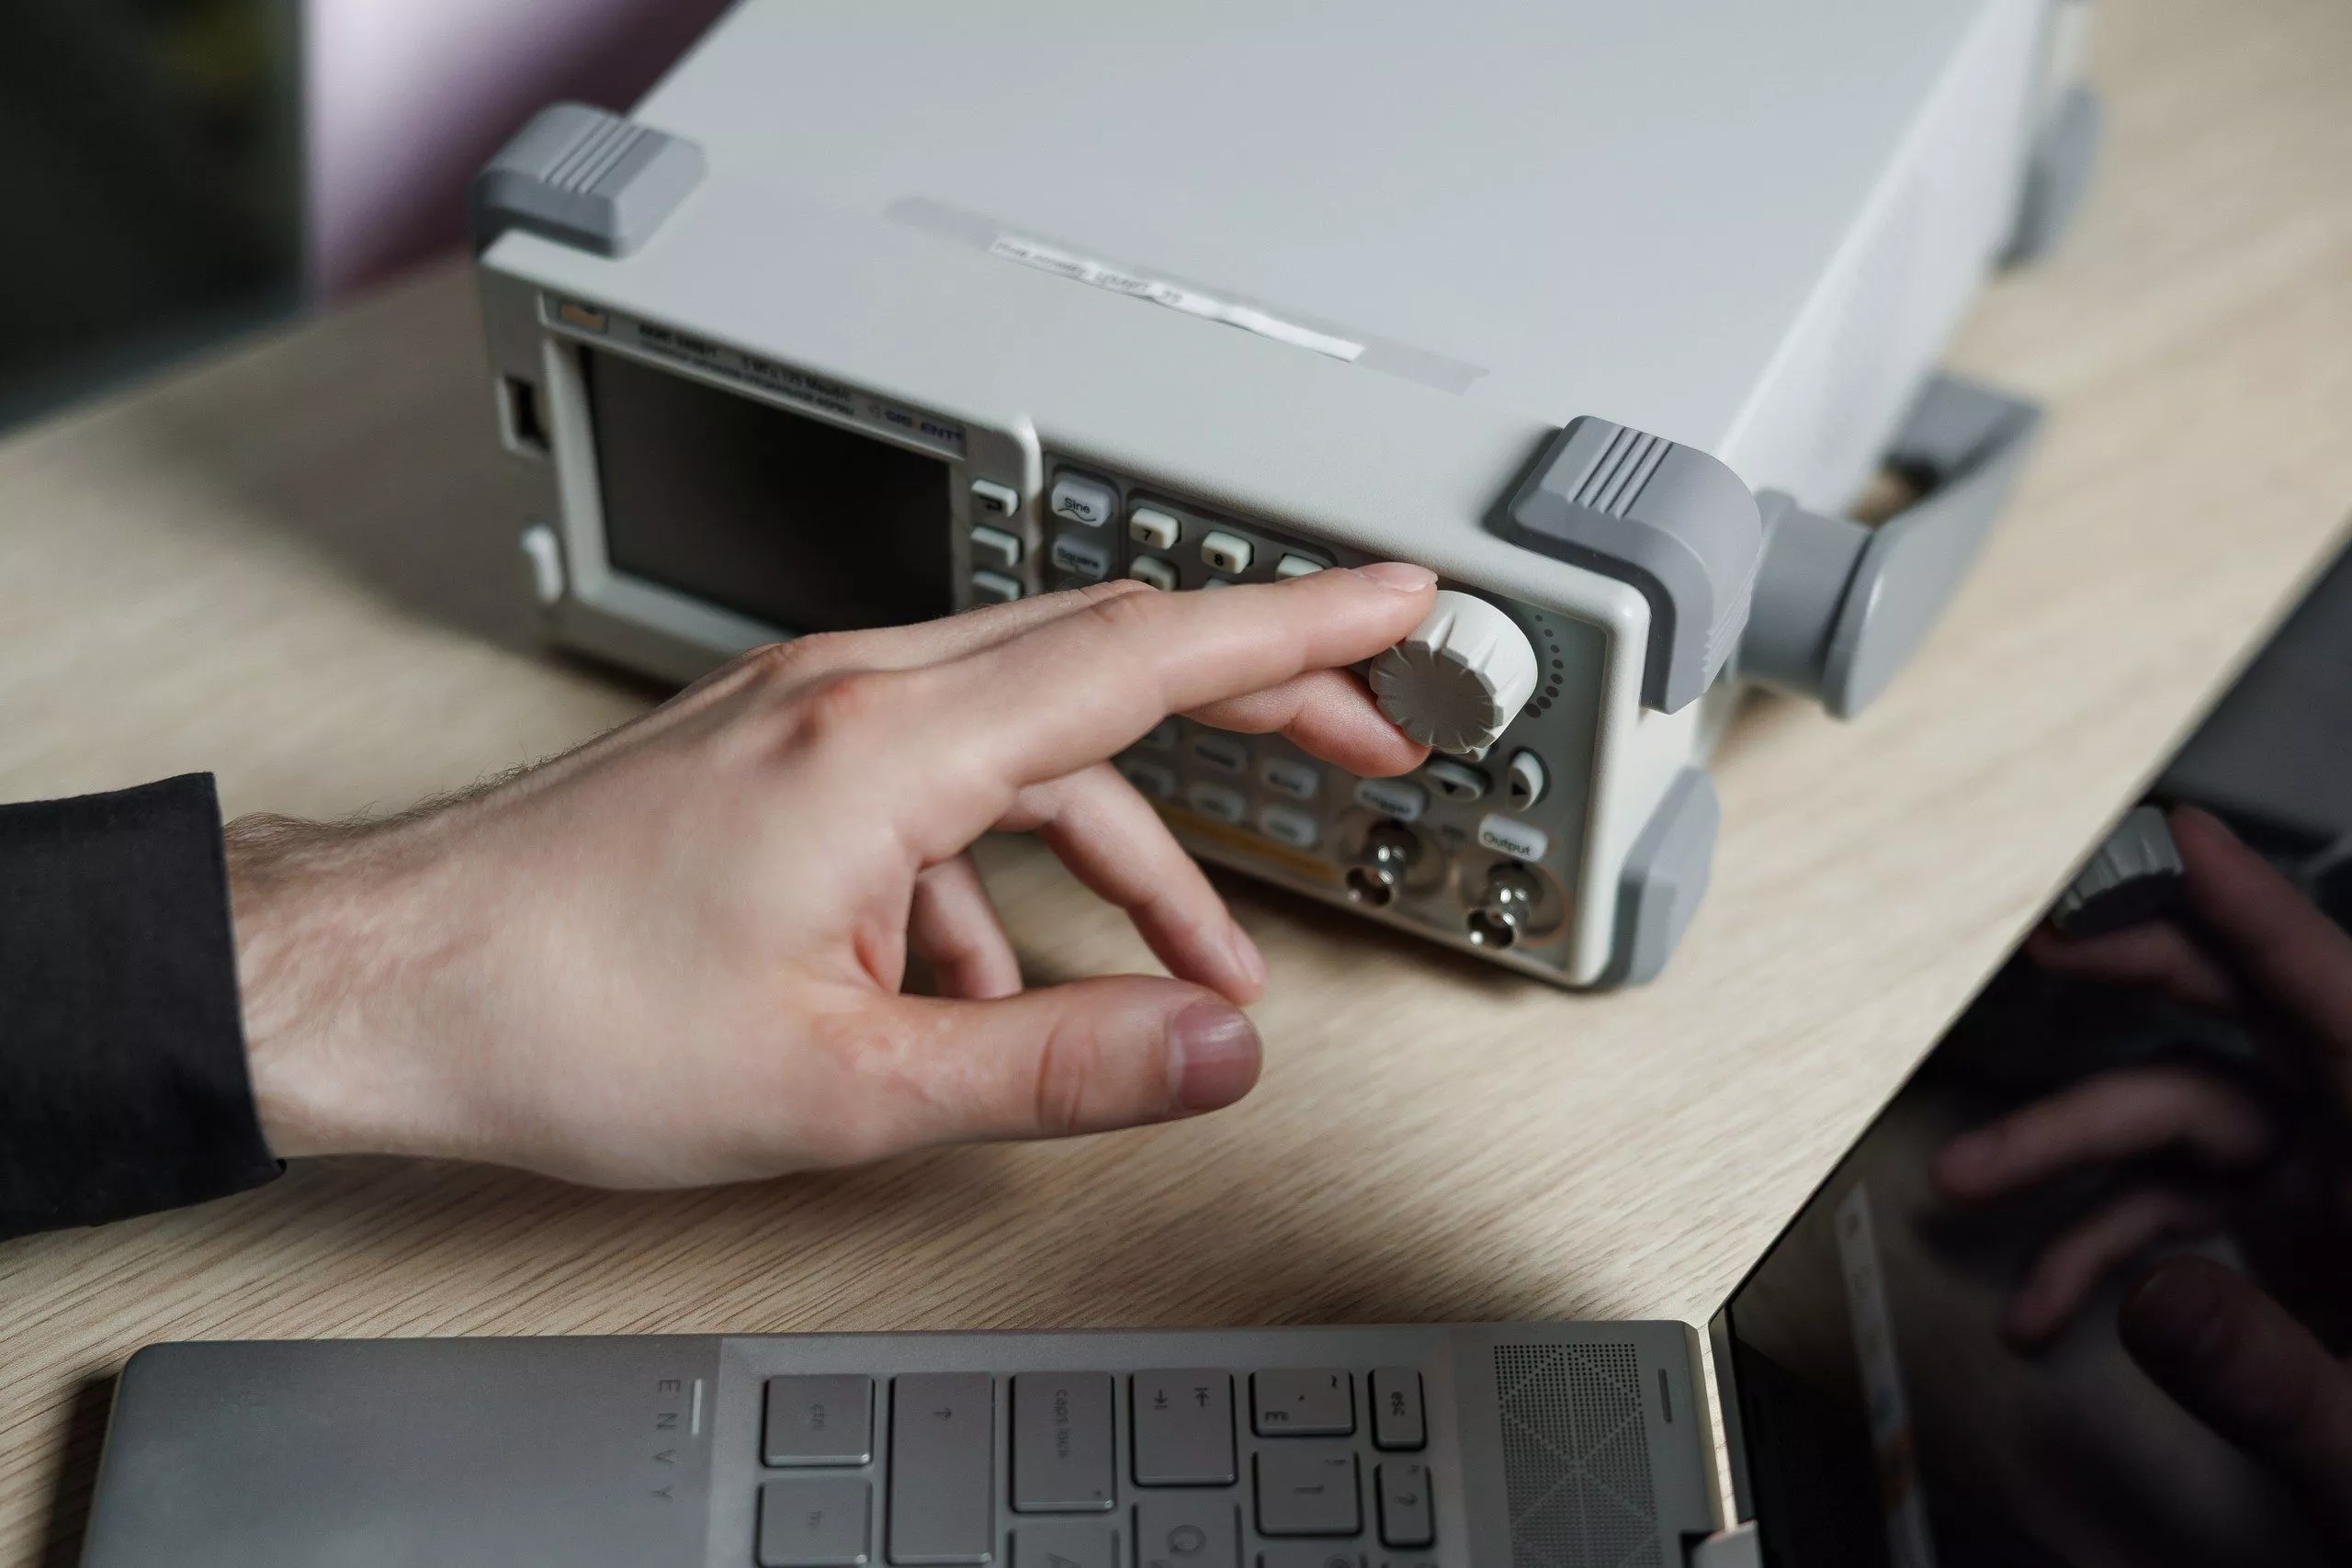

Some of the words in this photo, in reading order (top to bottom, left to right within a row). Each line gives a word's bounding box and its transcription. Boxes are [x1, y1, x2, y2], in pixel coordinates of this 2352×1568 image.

[884, 410, 957, 441] SIGENT
[1064, 497, 1091, 514] Sine
[1143, 528, 1152, 541] 7
[1057, 548, 1099, 569] Square
[1214, 553, 1225, 567] 8
[1484, 831, 1532, 855] Output
[1053, 1388, 1069, 1426] caps
[1391, 1391, 1406, 1417] esc
[650, 1378, 682, 1502] ENVY
[1054, 1427, 1069, 1460] lock
[1167, 1525, 1207, 1557] Q
